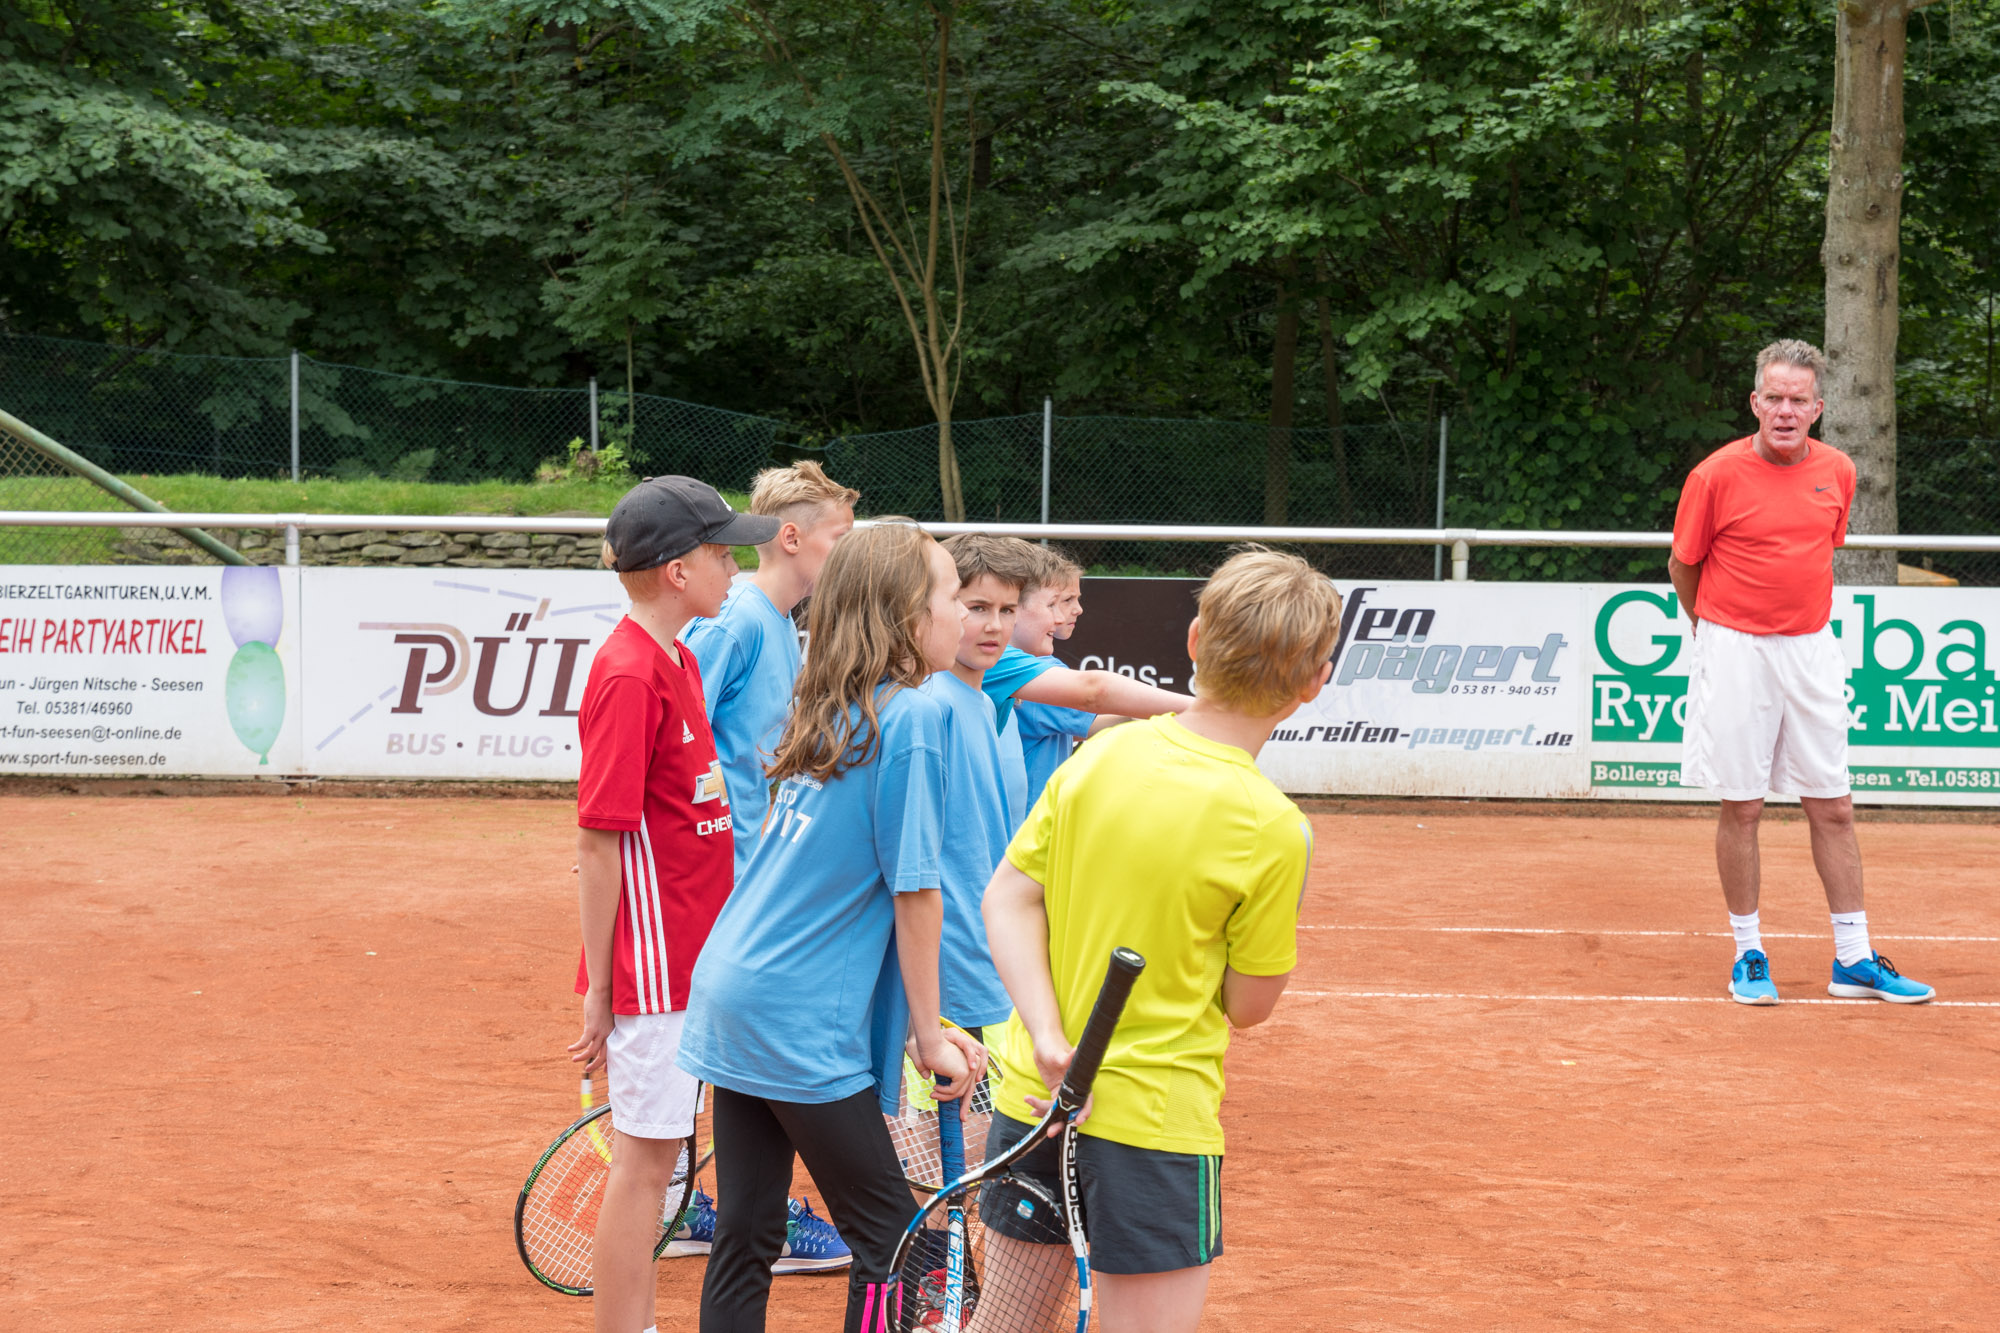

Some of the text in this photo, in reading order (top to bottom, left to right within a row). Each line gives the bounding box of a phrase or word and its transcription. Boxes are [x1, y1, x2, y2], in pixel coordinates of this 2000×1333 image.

[41, 618, 207, 655] PARTYARTIKEL
[1594, 589, 1995, 680] Gba
[1336, 633, 1569, 694] pägert
[29, 677, 79, 694] Jürgen
[83, 678, 137, 692] Nitsche
[151, 679, 203, 692] Seesen
[1462, 685, 1478, 695] 53
[1507, 686, 1531, 696] 940
[1534, 686, 1557, 696] 451
[16, 701, 133, 715] Tel. 05381/46960
[1884, 685, 1998, 732] Mei
[386, 733, 554, 758] BUS FLUG
